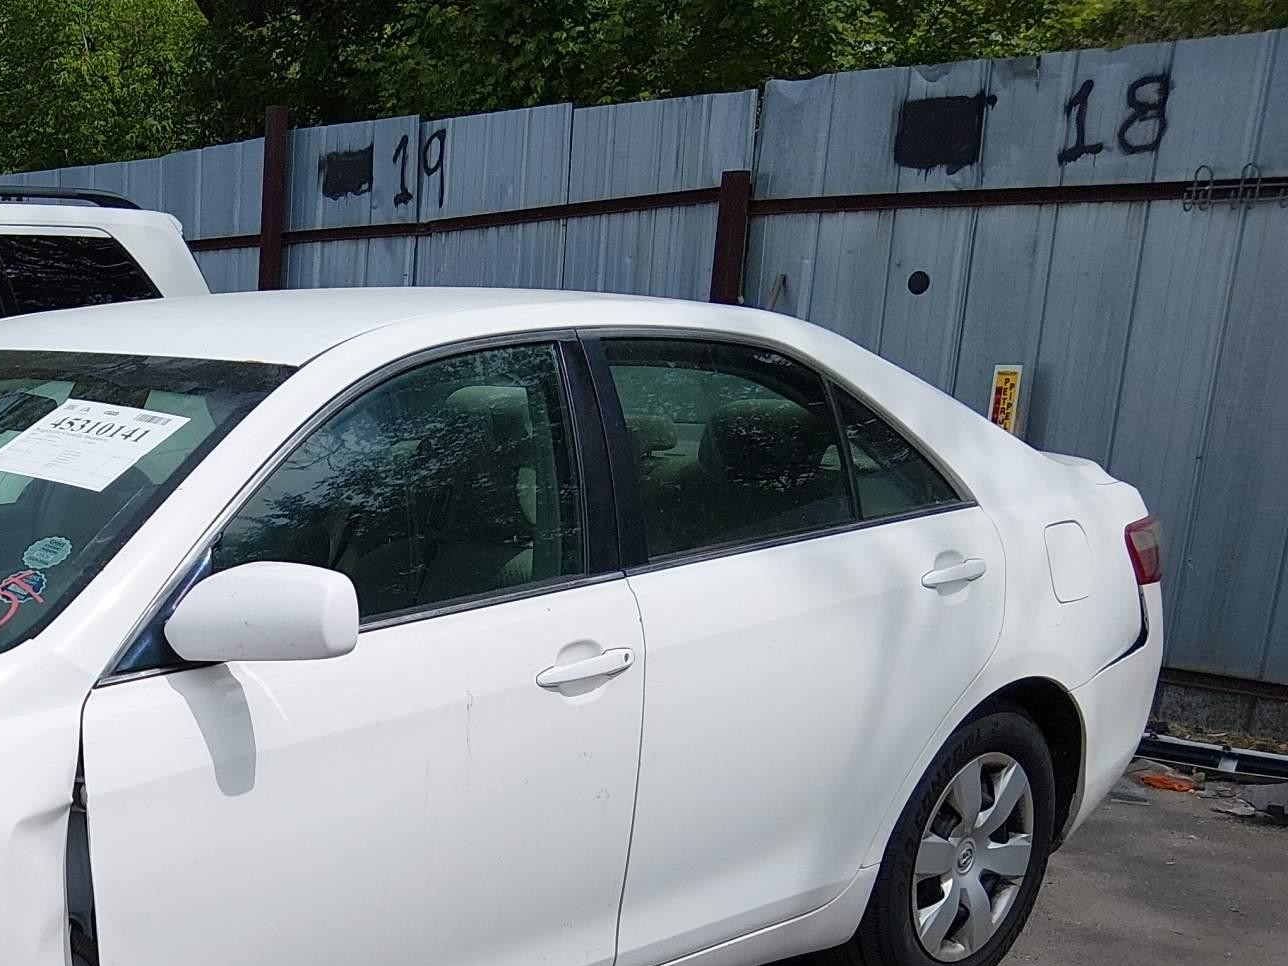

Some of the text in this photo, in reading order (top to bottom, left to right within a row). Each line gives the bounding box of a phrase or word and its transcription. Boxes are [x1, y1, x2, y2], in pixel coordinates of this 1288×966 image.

[1057, 73, 1173, 167] 18
[392, 128, 447, 209] 19
[50, 416, 151, 443] 45310141
